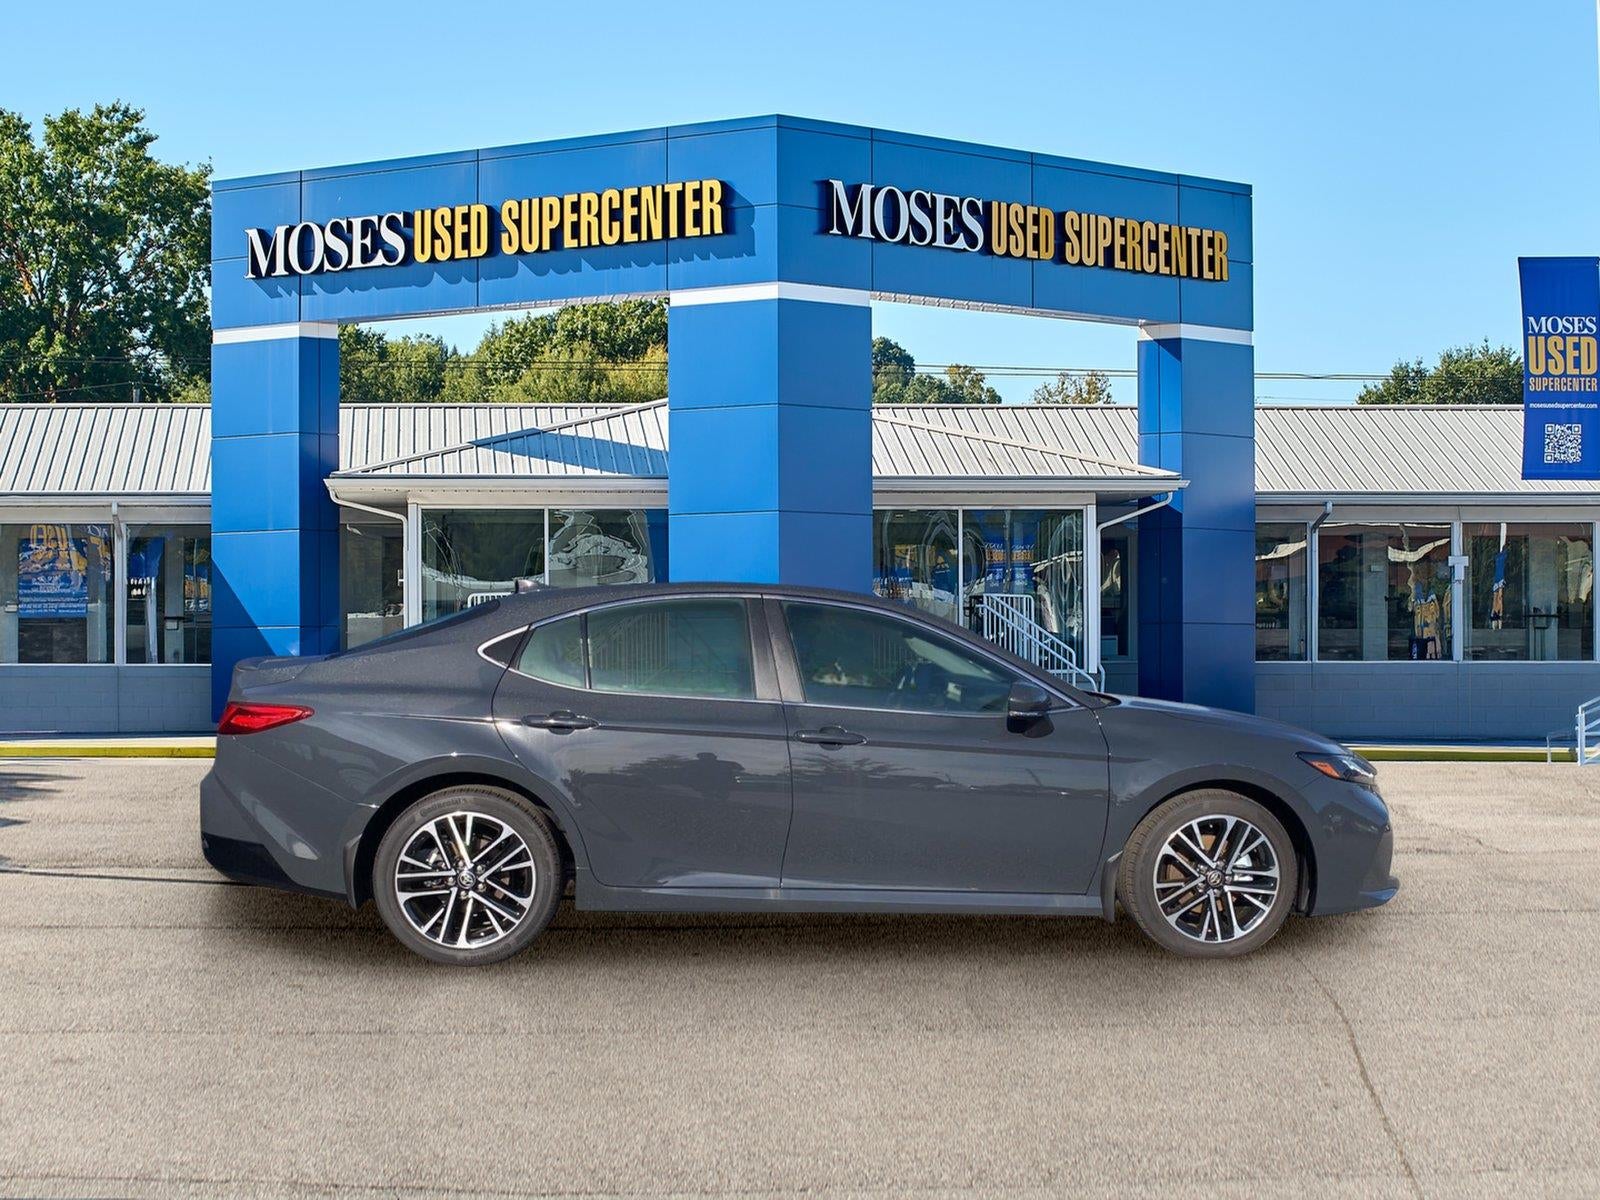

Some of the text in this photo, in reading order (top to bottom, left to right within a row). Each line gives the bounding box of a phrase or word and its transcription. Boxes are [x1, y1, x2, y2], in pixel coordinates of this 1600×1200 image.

[244, 178, 724, 279] MOSES USED SUPERCENTER
[828, 178, 1229, 281] MOSES USED SUPERCENTER
[1527, 316, 1597, 334] MOSES
[1528, 336, 1598, 375] USED
[1529, 377, 1598, 392] SUPERCENTER
[1529, 402, 1598, 410] mosesusedsupercenter.com
